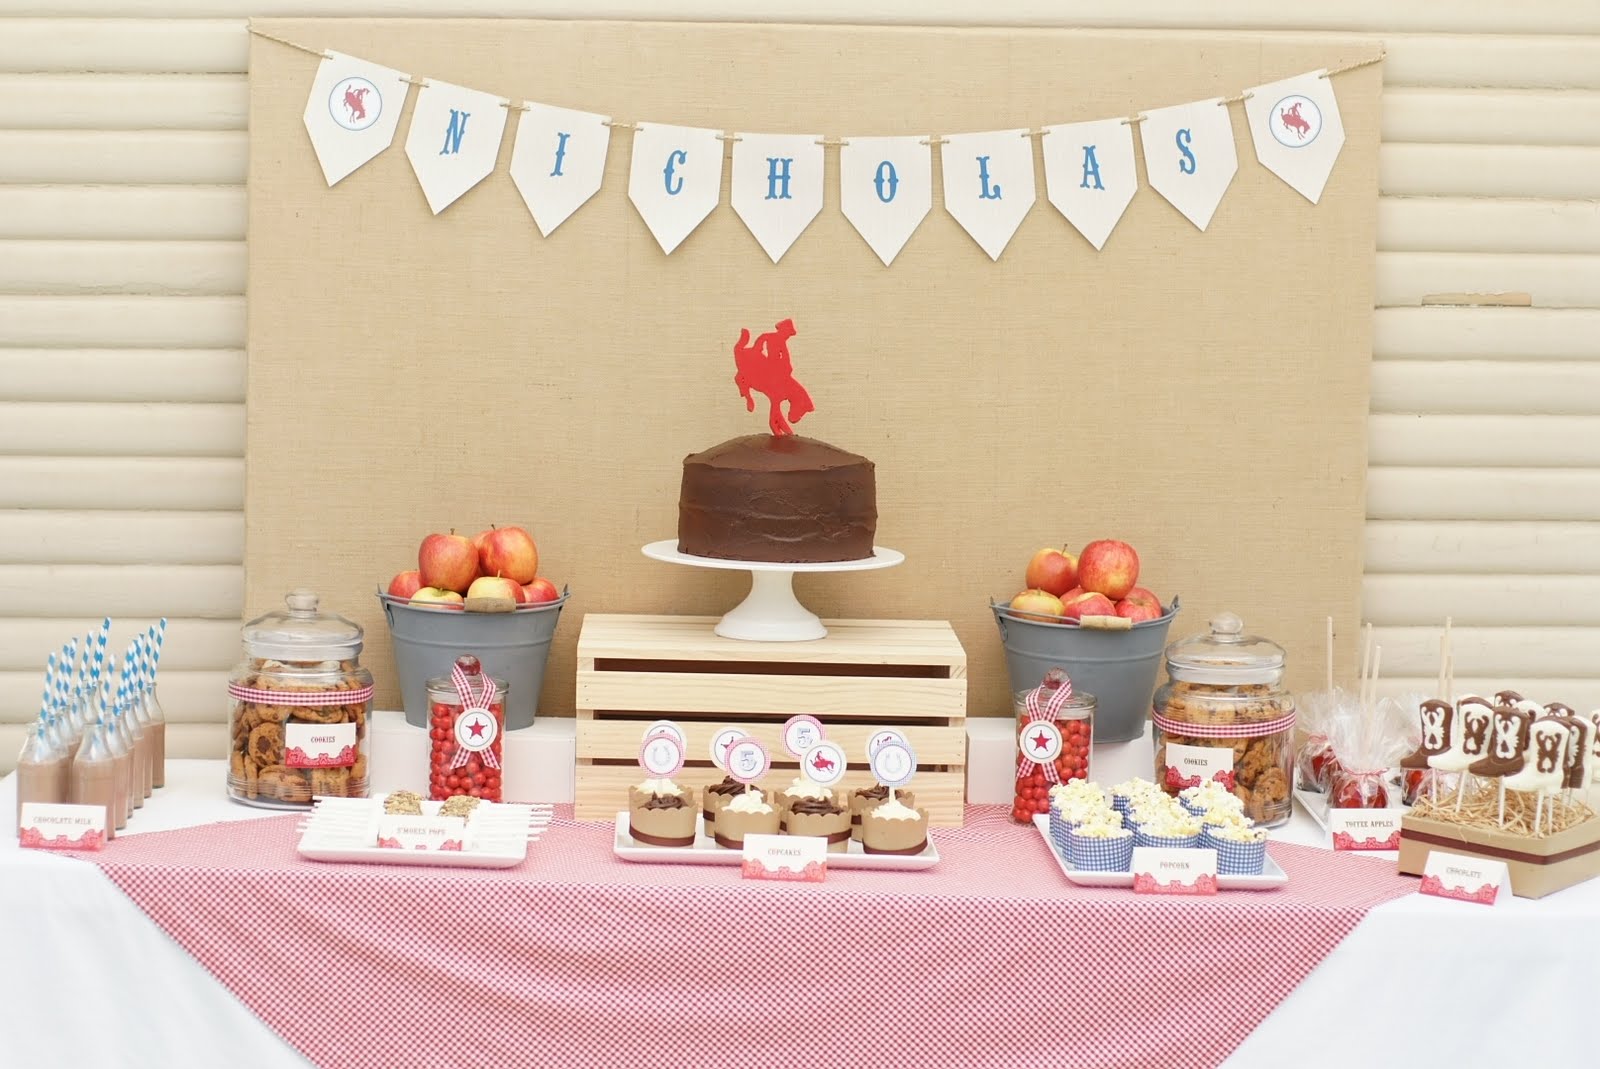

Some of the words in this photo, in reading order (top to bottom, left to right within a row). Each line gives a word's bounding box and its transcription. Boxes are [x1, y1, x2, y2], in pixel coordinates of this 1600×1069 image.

[797, 728, 814, 748] 5
[741, 749, 758, 771] 5
[1183, 757, 1208, 766] COOKIES
[33, 816, 73, 825] CHOCOLATE
[75, 817, 92, 825] MILK
[767, 848, 802, 856] CUPCAKES
[1159, 861, 1190, 869] POPCORN
